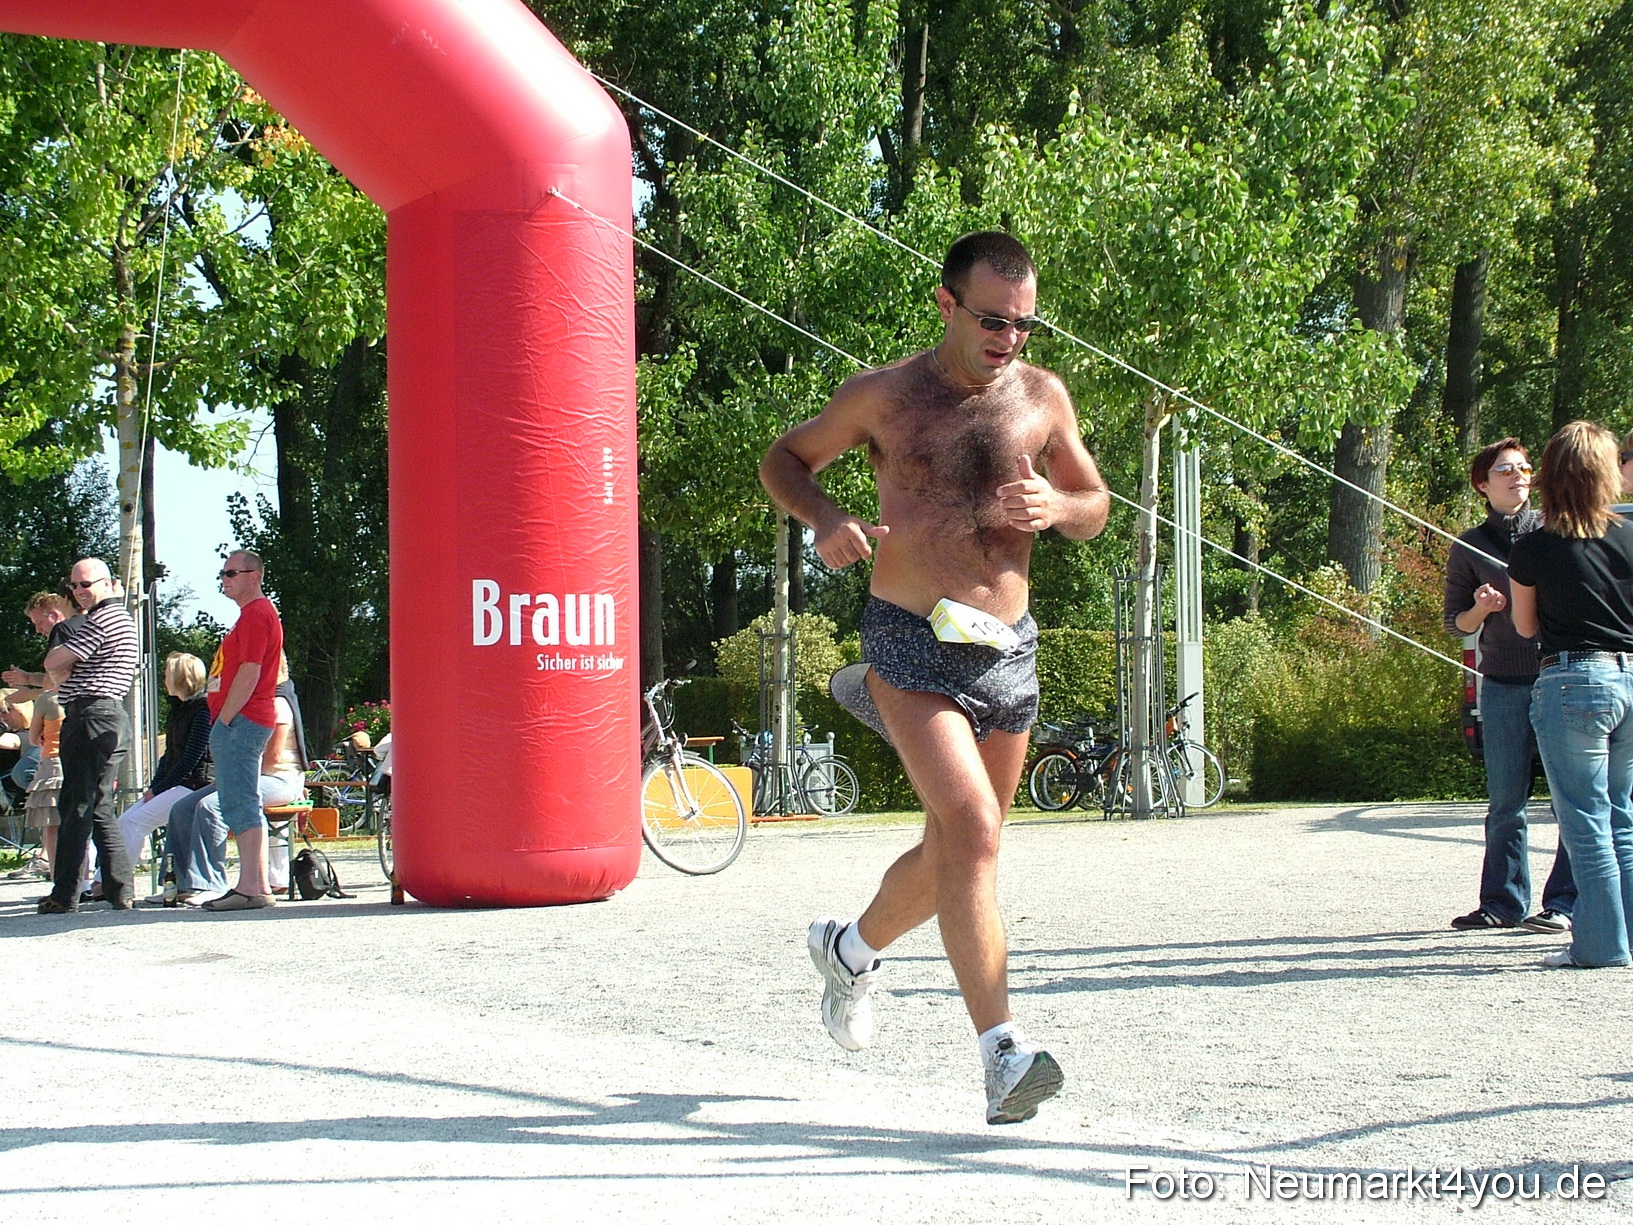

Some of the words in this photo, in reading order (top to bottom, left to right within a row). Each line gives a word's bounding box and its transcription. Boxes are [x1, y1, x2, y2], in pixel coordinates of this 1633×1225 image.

[472, 579, 616, 646] Braun
[536, 652, 578, 671] Sicher
[580, 653, 595, 670] ist
